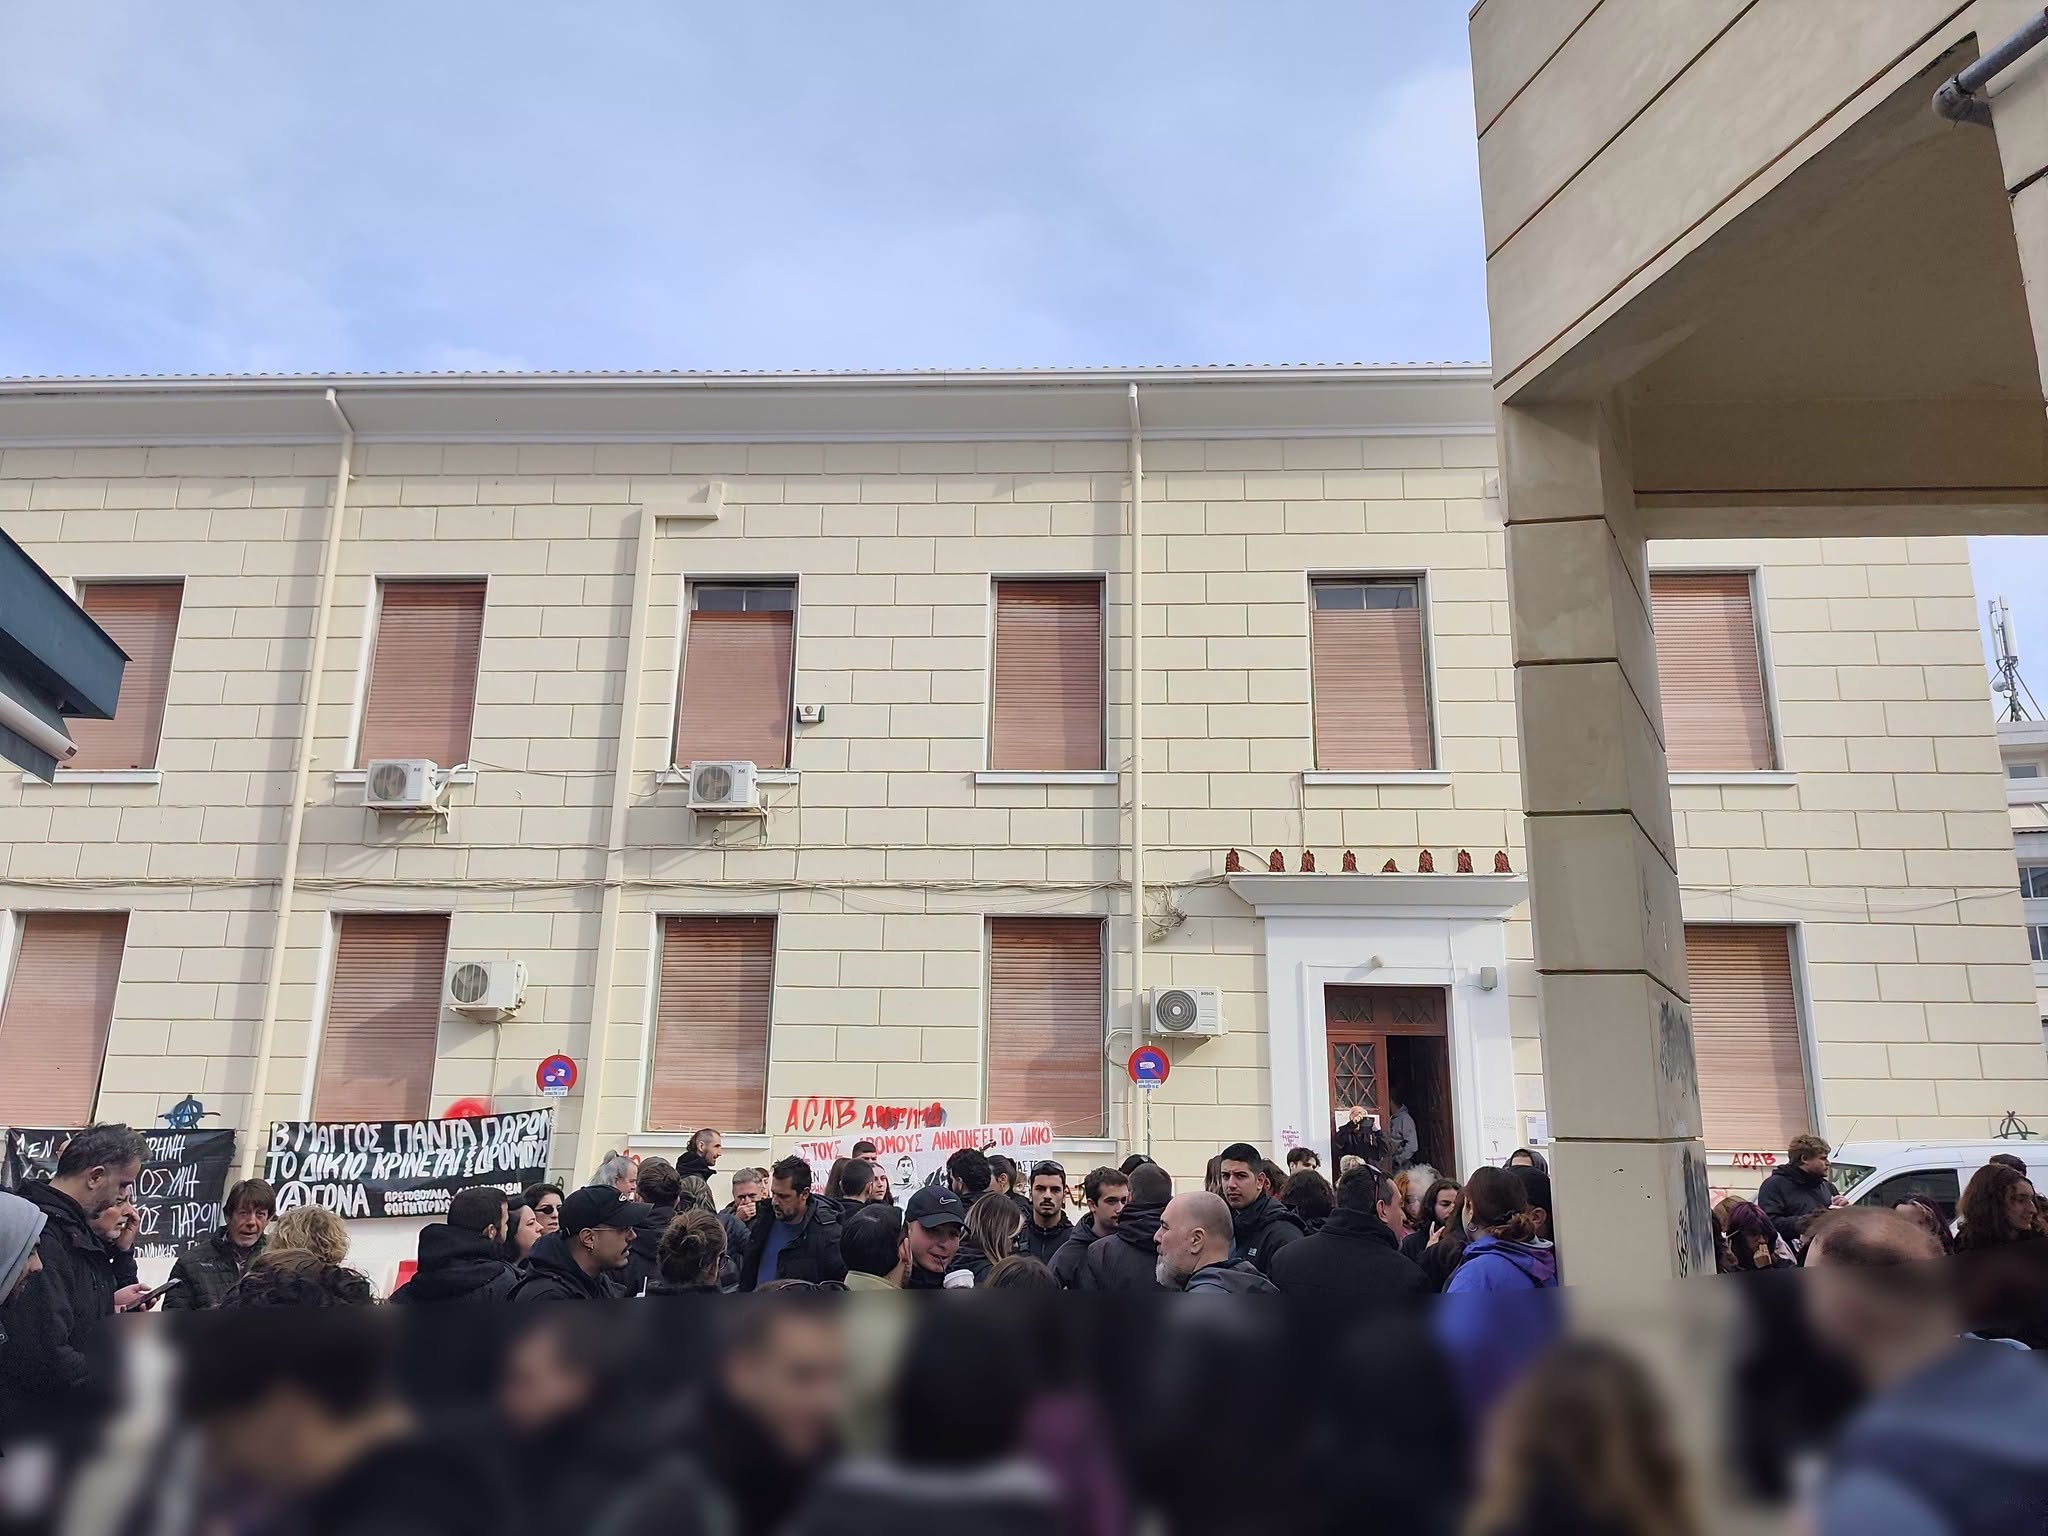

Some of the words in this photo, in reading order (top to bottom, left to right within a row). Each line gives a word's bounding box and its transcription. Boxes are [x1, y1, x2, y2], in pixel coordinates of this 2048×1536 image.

[294, 1122, 384, 1154] ΜΑΓΓΟΣ
[394, 1118, 477, 1152] ΠΑΝΤΑ
[482, 1109, 552, 1150] ΠΑΡΩΝ
[785, 1096, 857, 1133] ACAB
[266, 1151, 298, 1180] ΤΟ
[299, 1151, 368, 1182] ΔΙΚΙΟ
[371, 1149, 466, 1180] ΚΡΙΝΕΤΑΙ
[474, 1139, 549, 1175] ΔΡΟΜΟΥΣ
[800, 1139, 843, 1163] ΣΤΟΥΣ
[999, 1127, 1014, 1146] ΤΟ
[1020, 1125, 1051, 1146] ΔΙΚΙΟ
[1731, 1152, 1776, 1169] ACAB
